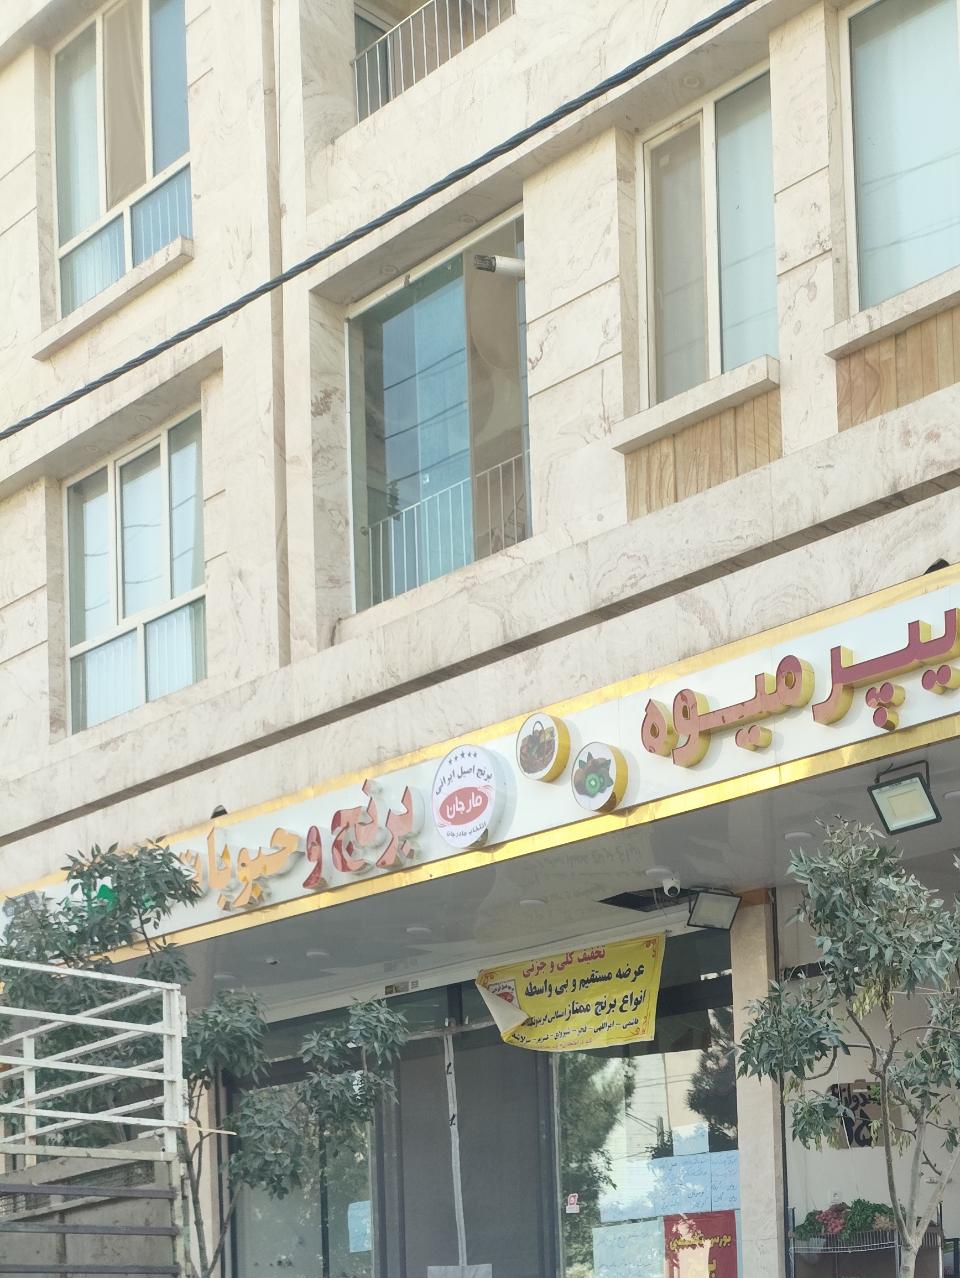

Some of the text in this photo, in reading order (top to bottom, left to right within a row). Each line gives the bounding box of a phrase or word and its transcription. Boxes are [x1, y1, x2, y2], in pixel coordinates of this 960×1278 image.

[446, 791, 483, 819] مارجان
[331, 778, 422, 873] برنج
[302, 825, 325, 889] و
[557, 951, 576, 971] کلی
[577, 945, 606, 964] تخفیف
[579, 969, 613, 990] مستقیم
[615, 962, 645, 983] عرضه
[524, 978, 552, 997] واسطه
[555, 979, 569, 996] بی
[571, 980, 577, 993] و
[565, 1000, 591, 1021] ممتاز
[594, 995, 617, 1016] برنج
[619, 989, 647, 1013] انواع
